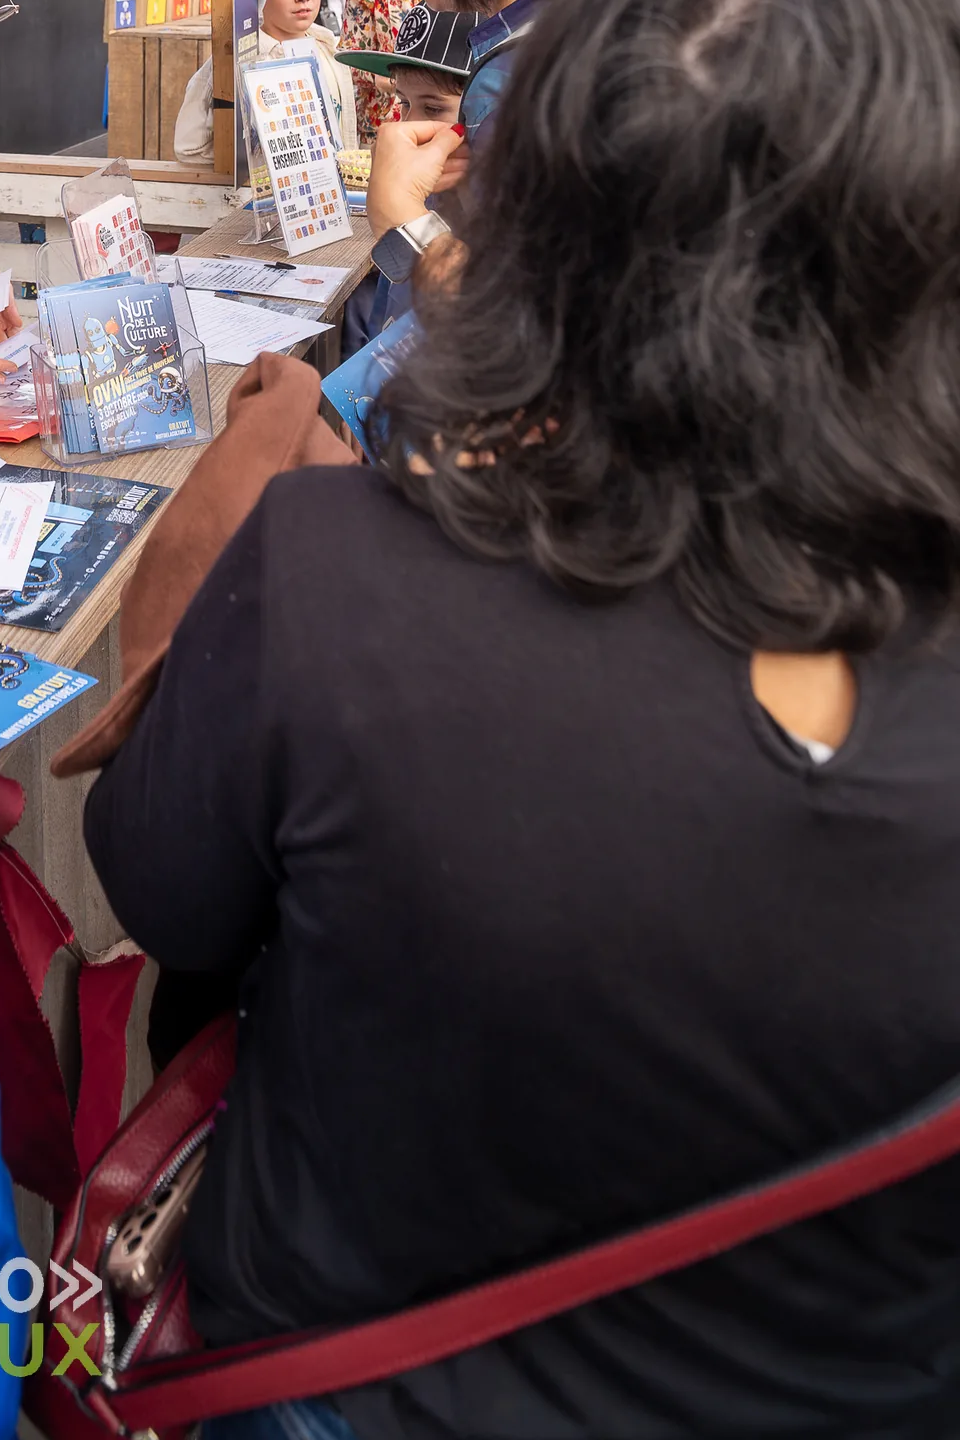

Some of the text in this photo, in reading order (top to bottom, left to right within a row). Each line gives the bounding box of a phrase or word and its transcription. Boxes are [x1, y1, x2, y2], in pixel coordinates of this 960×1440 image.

[267, 131, 304, 154] ICI ON RÊVE
[134, 316, 157, 328] DE LA
[92, 373, 126, 408] OVNI
[98, 408, 105, 421] 3
[104, 391, 138, 418] OCTOBRE
[101, 406, 137, 432] ESCH-BELVAL
[17, 671, 73, 709] GRATUIT
